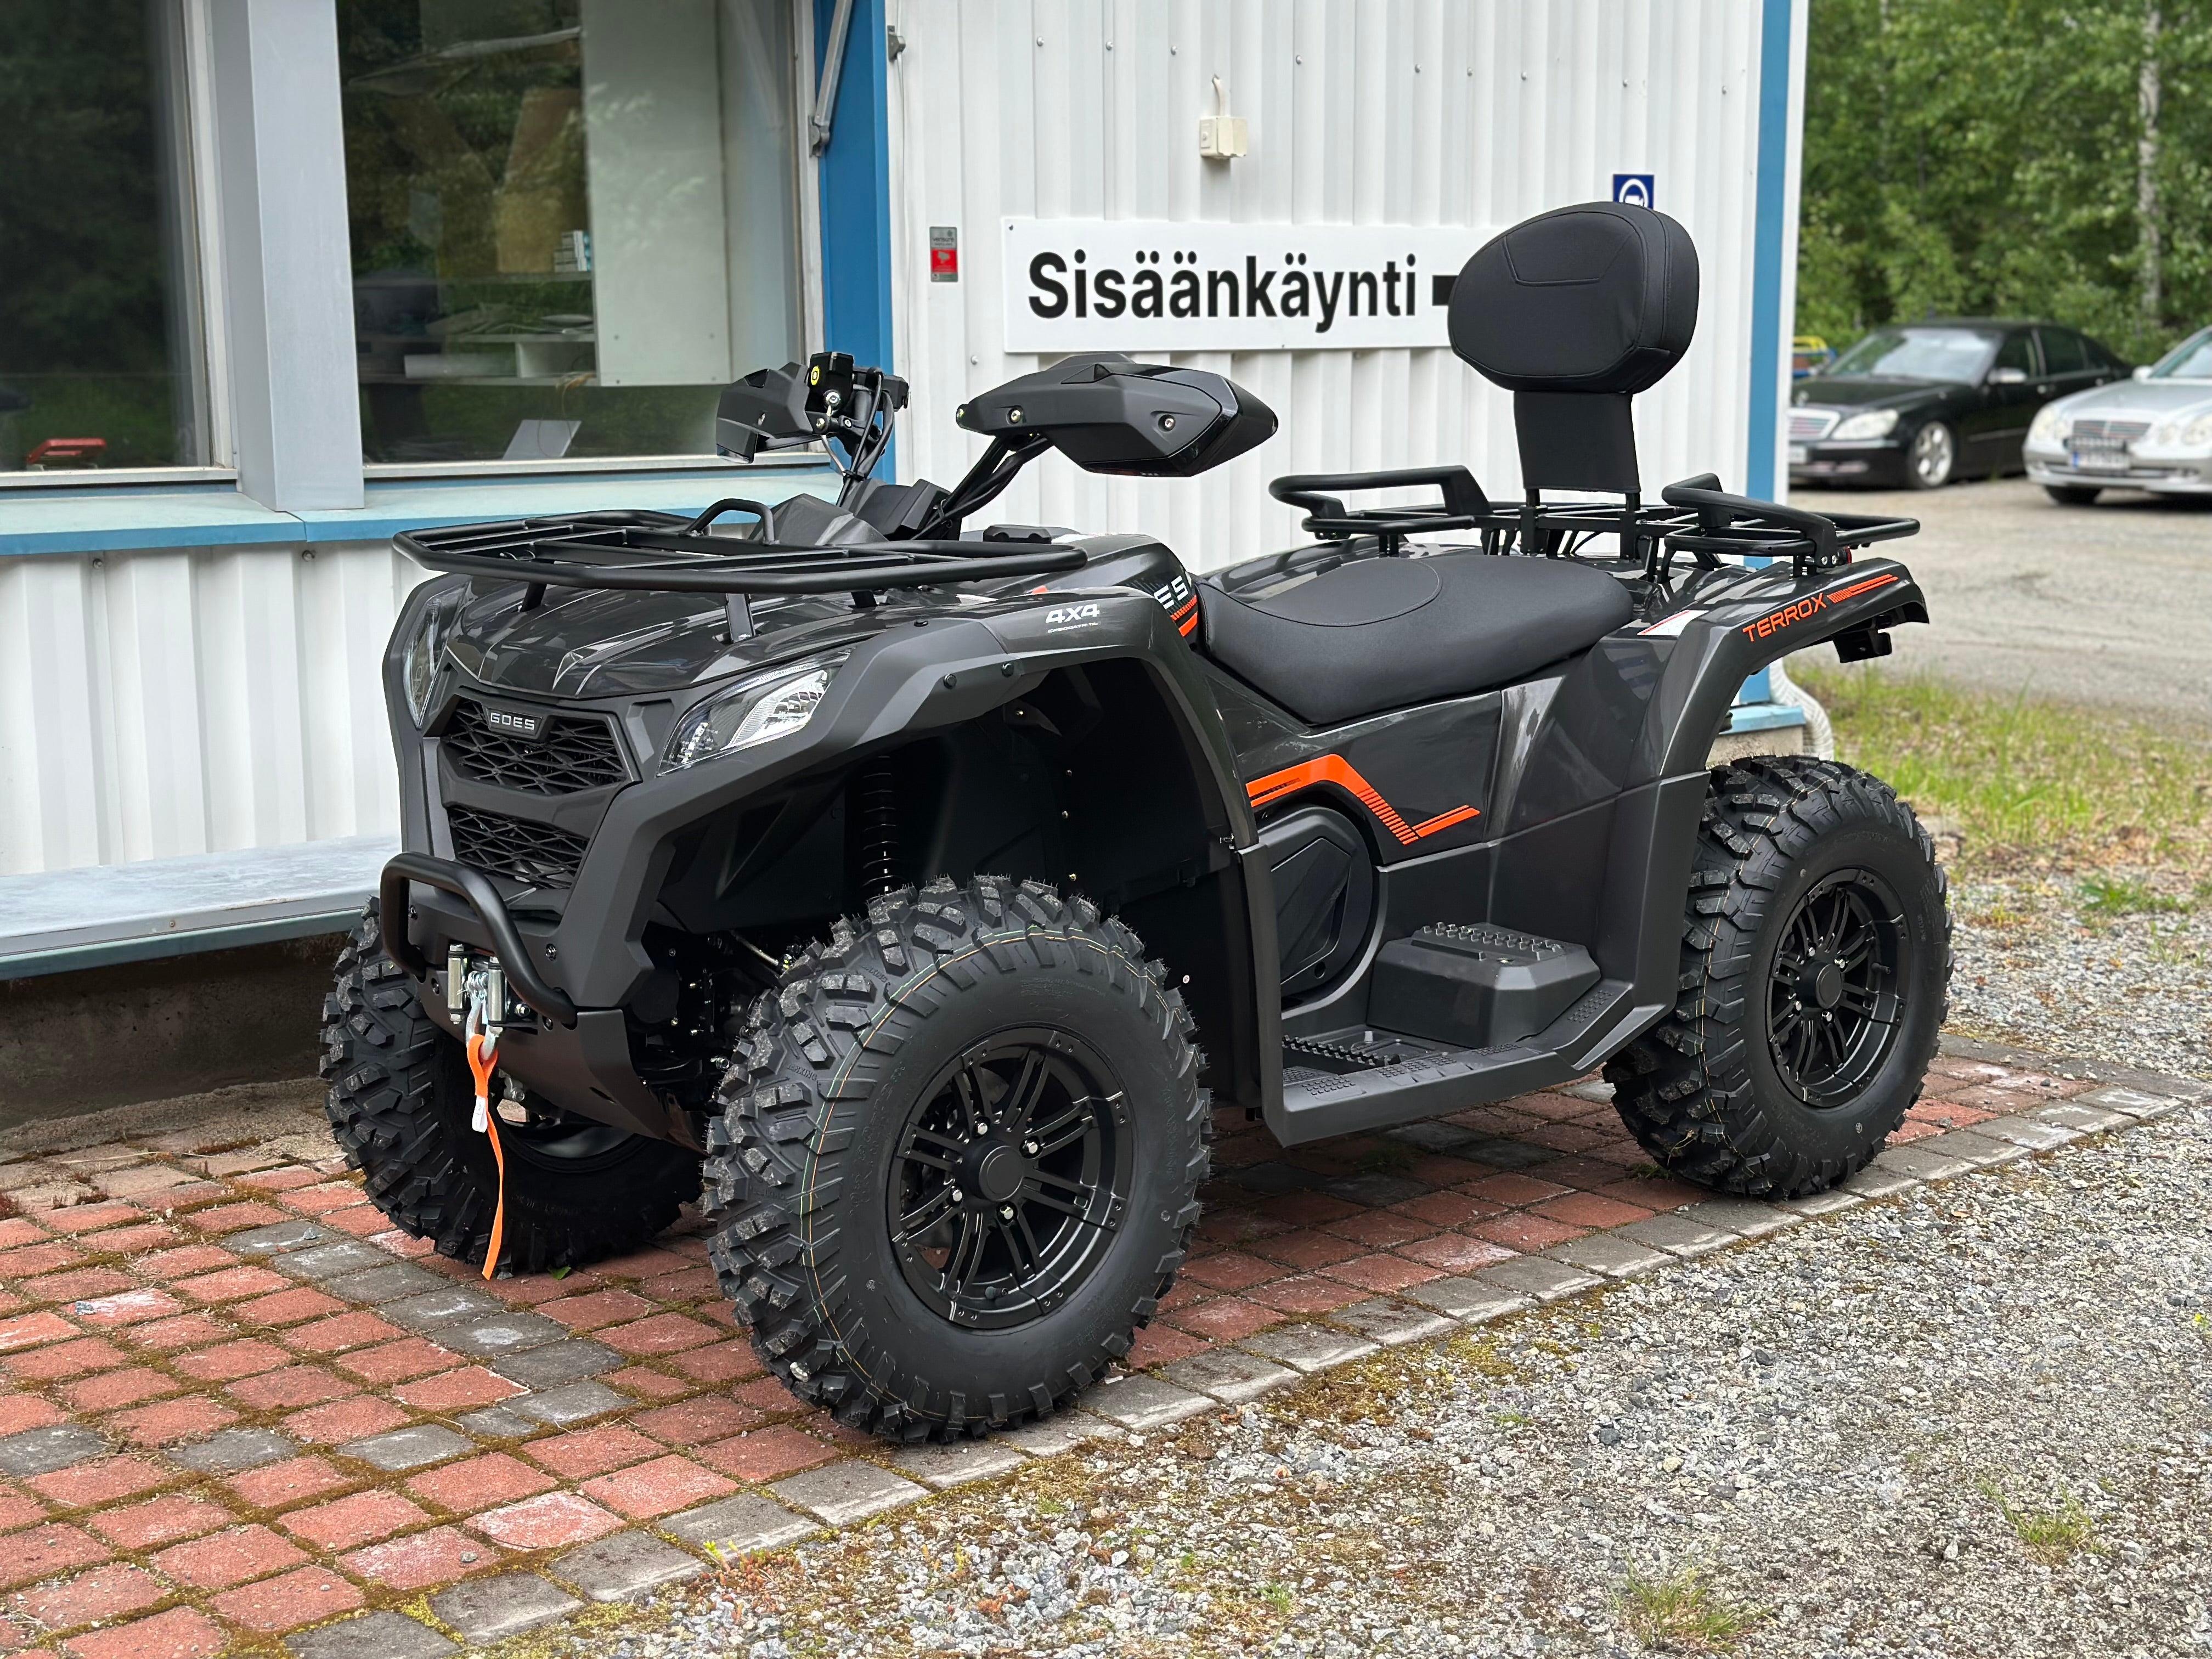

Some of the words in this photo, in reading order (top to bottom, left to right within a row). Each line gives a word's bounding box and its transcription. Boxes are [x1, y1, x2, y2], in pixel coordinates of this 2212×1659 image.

[1029, 249, 1416, 334] Sisäänkäynti
[1153, 575, 1188, 610] ES
[1742, 592, 1827, 642] TERROX
[490, 712, 534, 730] GOES
